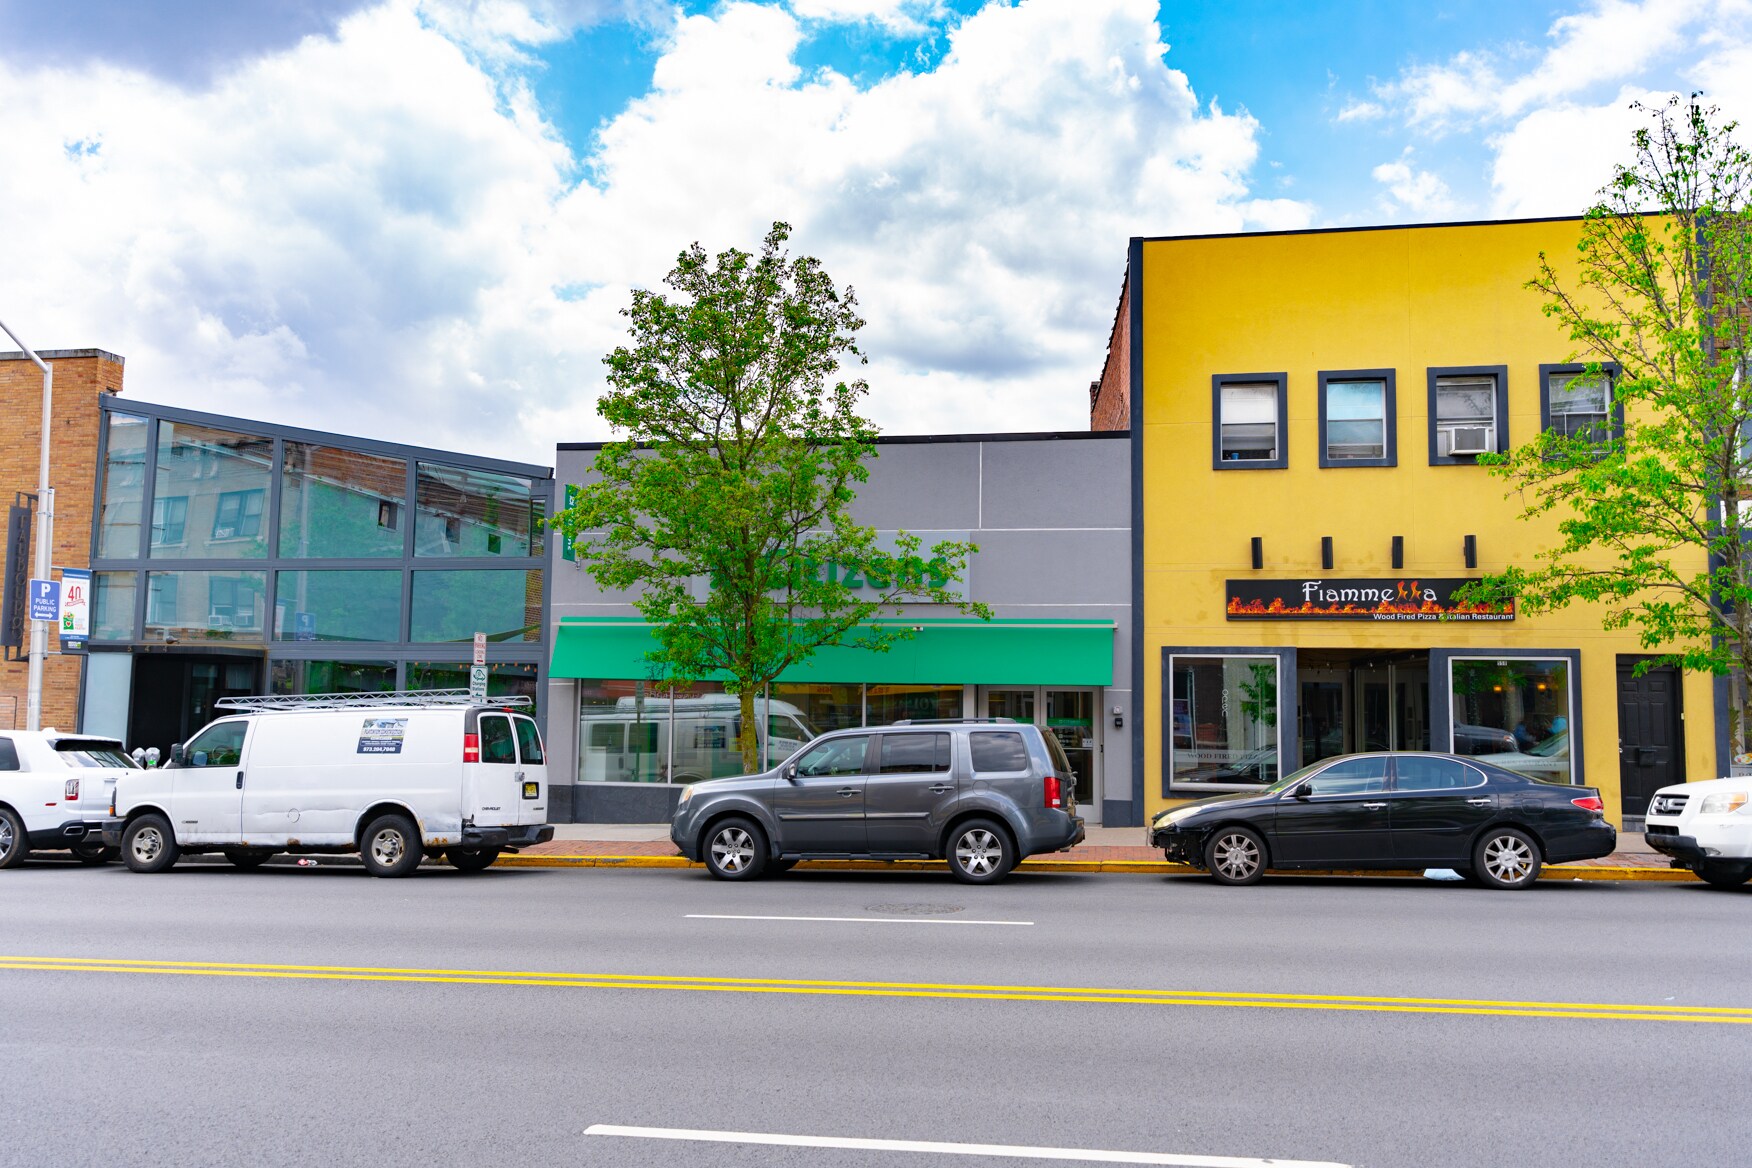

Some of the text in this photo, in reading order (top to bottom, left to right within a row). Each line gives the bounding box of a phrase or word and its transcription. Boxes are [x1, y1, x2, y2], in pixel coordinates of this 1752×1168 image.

[41, 583, 51, 598] P
[1302, 580, 1437, 602] Fiammella
[33, 605, 57, 613] PARKING
